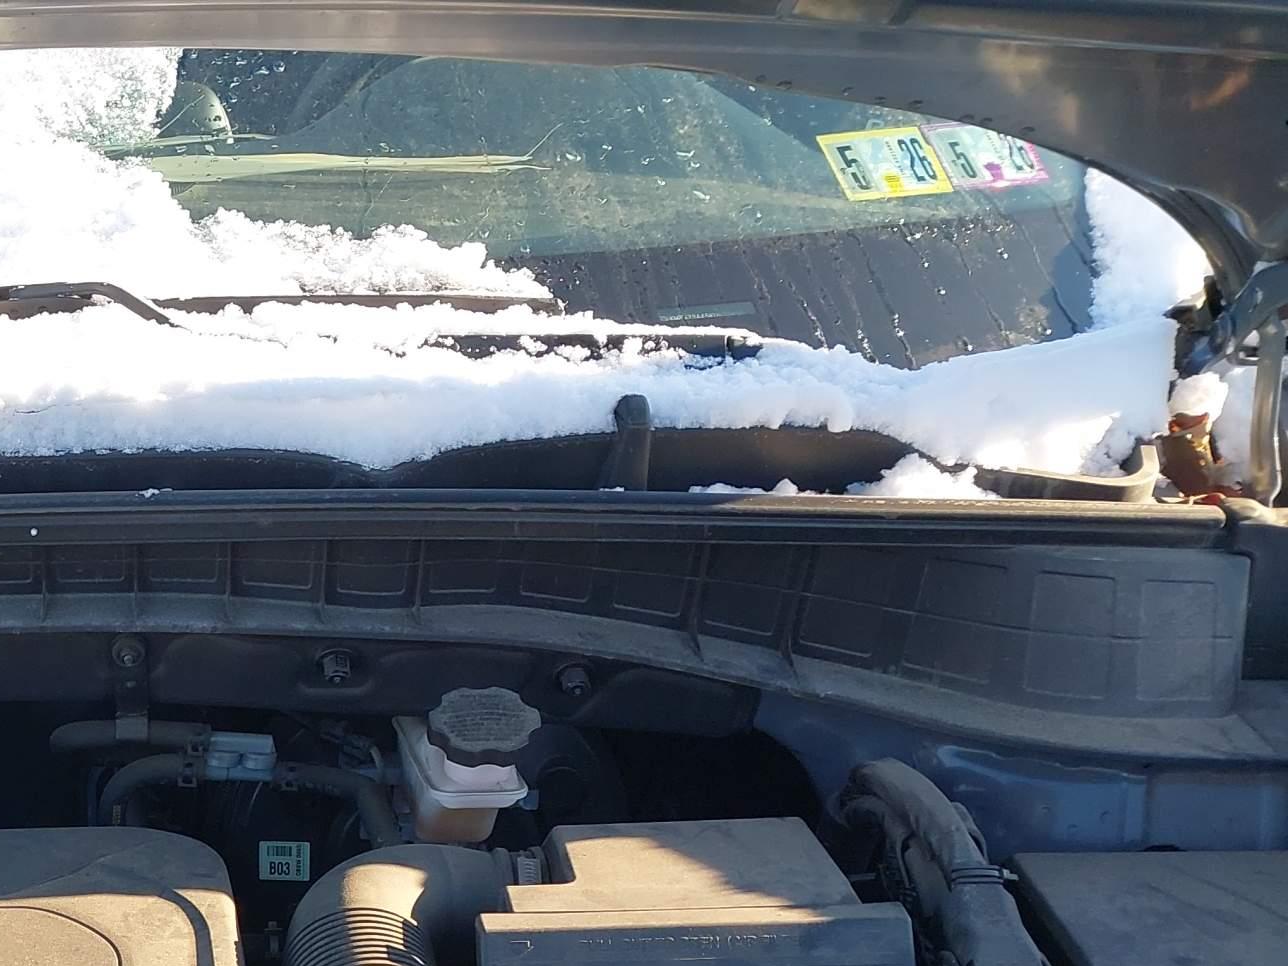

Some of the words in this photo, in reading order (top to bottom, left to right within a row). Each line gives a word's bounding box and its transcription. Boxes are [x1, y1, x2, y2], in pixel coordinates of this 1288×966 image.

[835, 144, 873, 190] 5
[897, 137, 938, 182] 26
[948, 141, 978, 178] 5
[269, 861, 291, 876] B03
